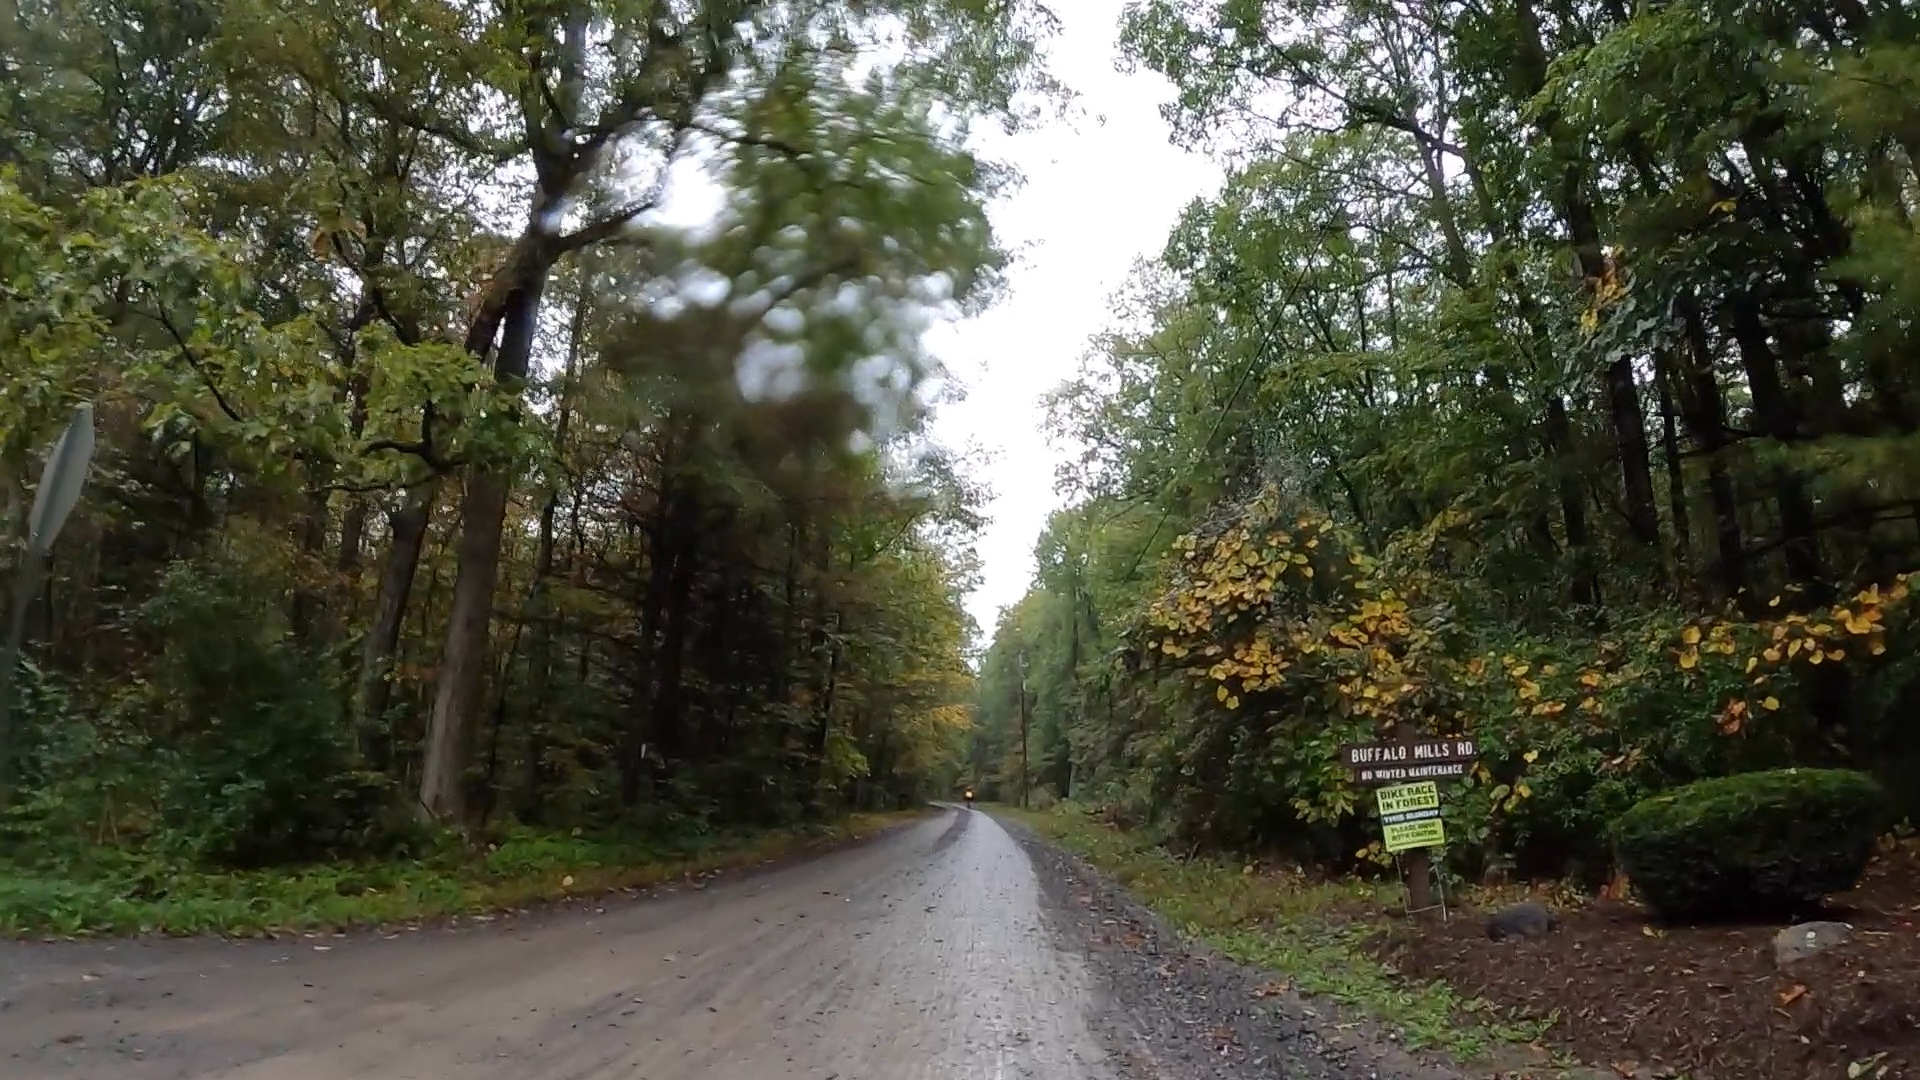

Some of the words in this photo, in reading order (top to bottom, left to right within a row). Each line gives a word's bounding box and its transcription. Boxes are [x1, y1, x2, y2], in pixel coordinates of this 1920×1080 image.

[1351, 746, 1407, 763] BUFFALO
[1414, 743, 1449, 759] MILLS
[1457, 741, 1477, 756] RD.
[1361, 770, 1373, 780] NO
[1380, 787, 1404, 800] BIKE
[1407, 785, 1435, 796] RACE
[1382, 800, 1394, 811] IN
[1396, 795, 1435, 809] FOREST
